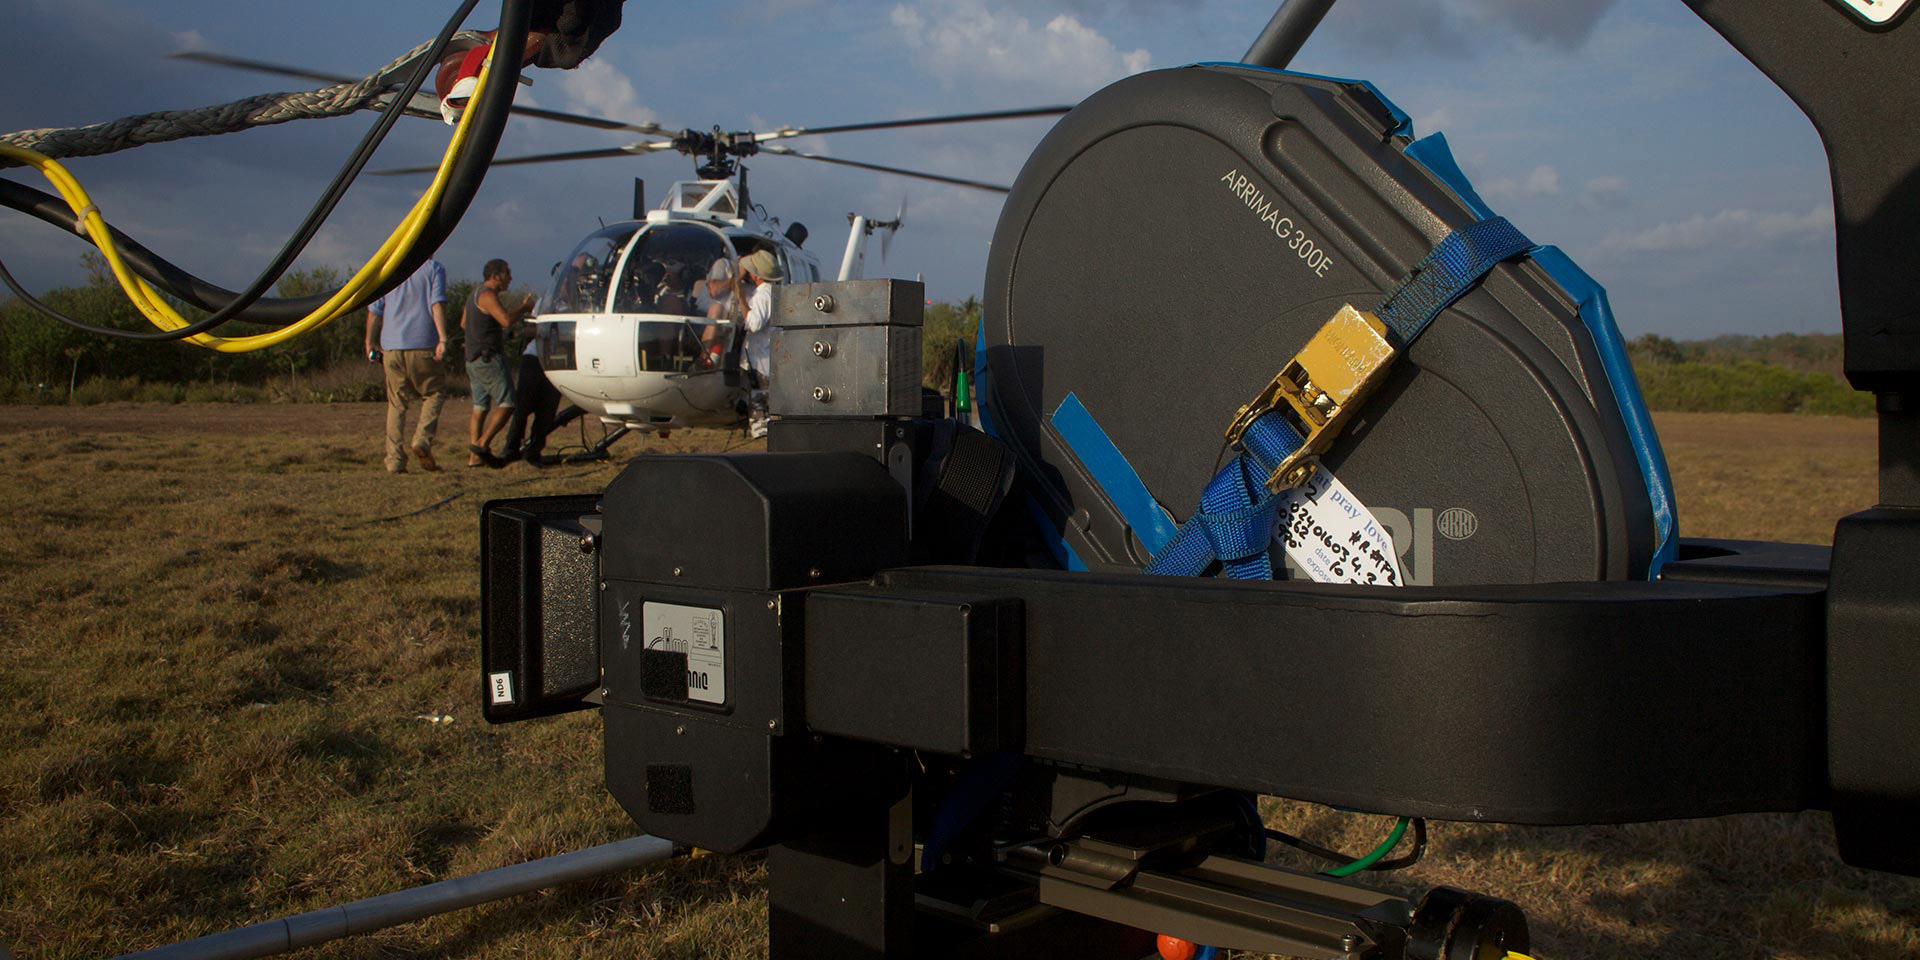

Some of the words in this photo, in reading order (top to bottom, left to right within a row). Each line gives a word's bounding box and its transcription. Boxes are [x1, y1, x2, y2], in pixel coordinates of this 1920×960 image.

[1221, 168, 1294, 238] ARRIMAG
[1288, 230, 1333, 278] 300E
[1329, 489, 1361, 519] pray
[1363, 519, 1389, 551] love
[1438, 508, 1477, 540] ARRI
[1307, 557, 1338, 584] expose
[1315, 547, 1331, 566] date
[495, 678, 505, 698] ND6
